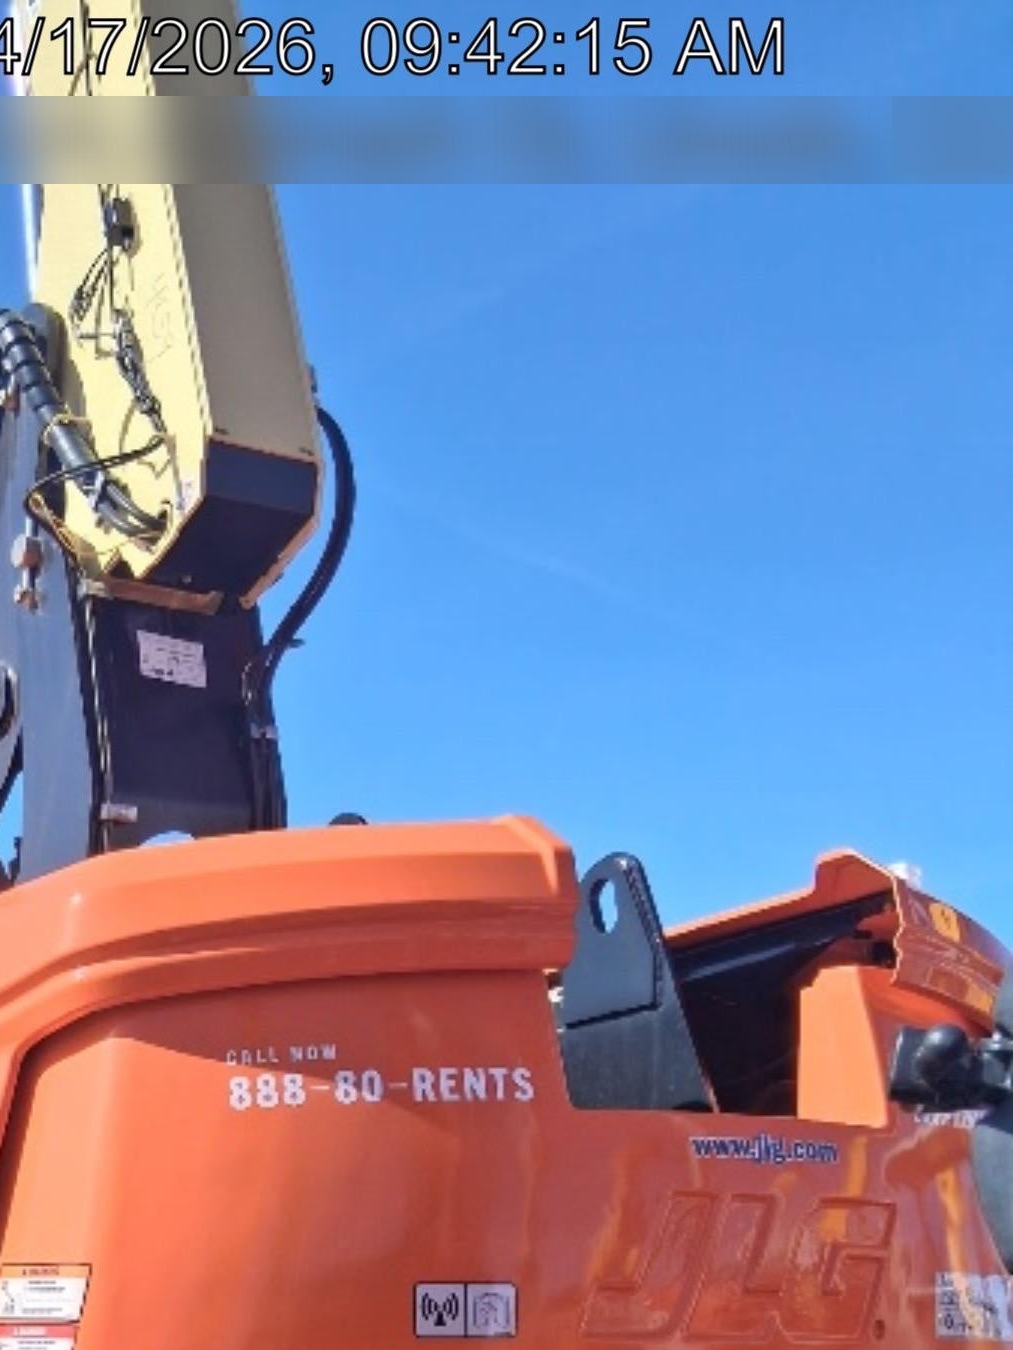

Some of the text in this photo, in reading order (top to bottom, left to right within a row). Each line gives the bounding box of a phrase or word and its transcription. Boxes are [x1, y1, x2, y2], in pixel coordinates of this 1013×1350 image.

[226, 1043, 336, 1067] CALL NOW
[691, 1133, 837, 1165] www.jlg.com
[581, 1189, 897, 1344] JLG
